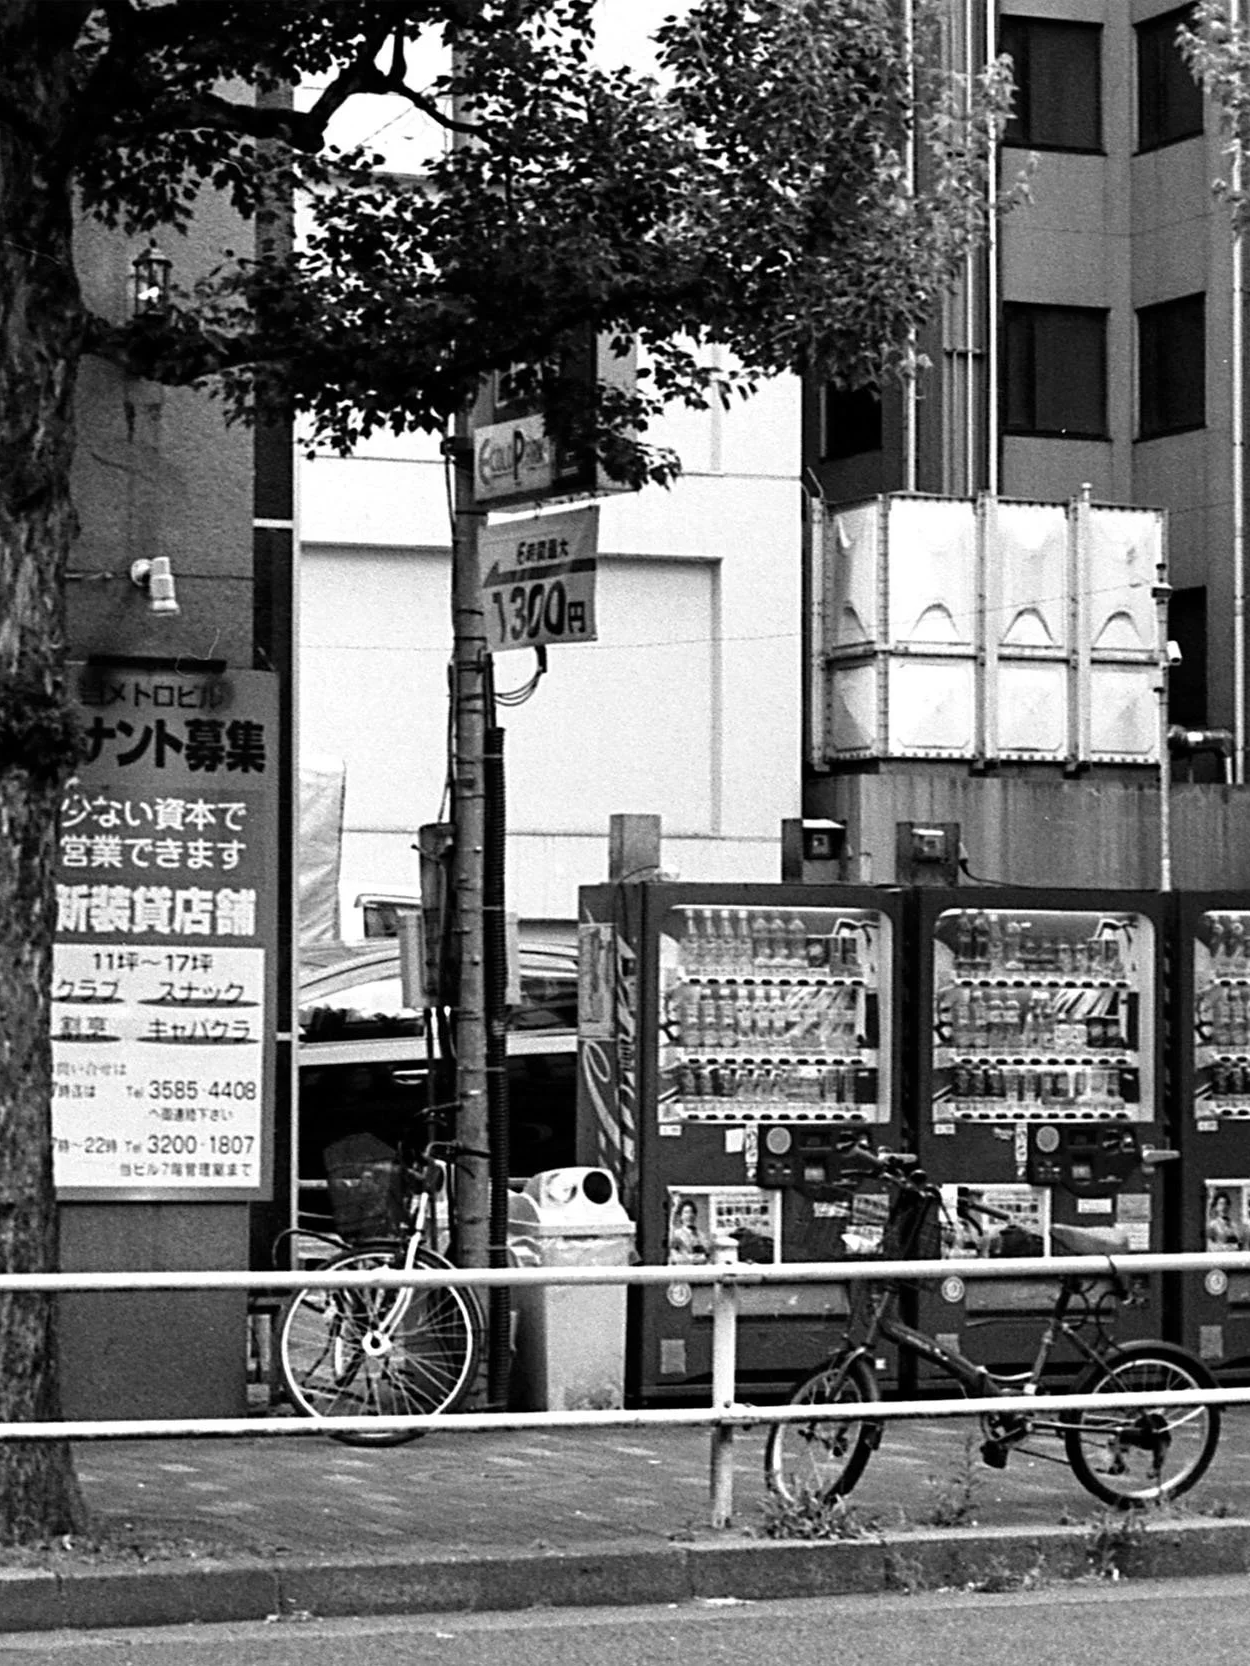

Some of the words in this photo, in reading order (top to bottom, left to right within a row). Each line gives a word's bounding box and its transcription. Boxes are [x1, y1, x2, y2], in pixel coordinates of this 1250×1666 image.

[60, 793, 247, 831] 少ない資本で
[60, 834, 247, 871] 営業できます
[159, 981, 245, 1004] スナック
[148, 1018, 252, 1042] キャバクラ
[126, 1085, 144, 1098] Tel
[125, 1141, 142, 1154] Tel
